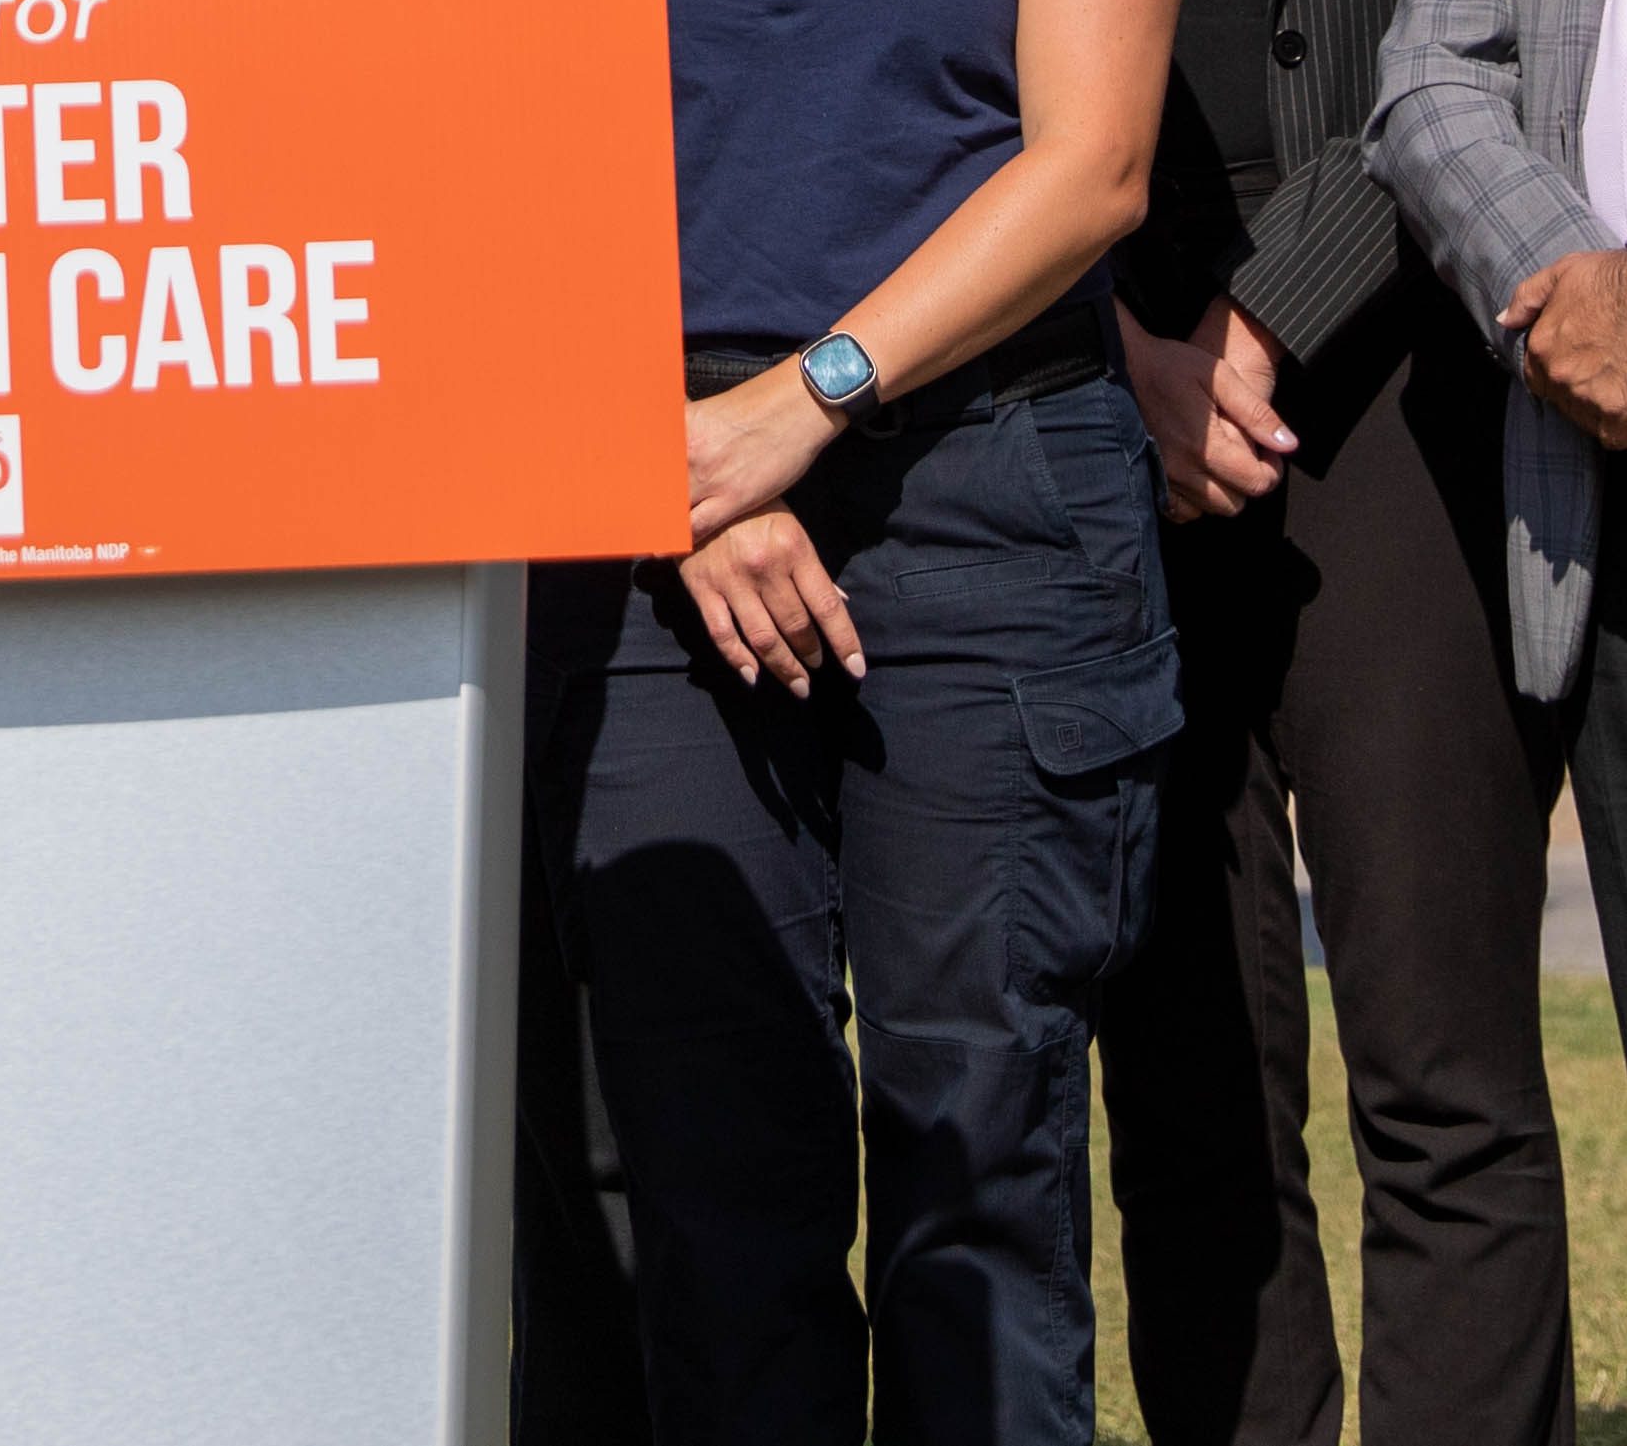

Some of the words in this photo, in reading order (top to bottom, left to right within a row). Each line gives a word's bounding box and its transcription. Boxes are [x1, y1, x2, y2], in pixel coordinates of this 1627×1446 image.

[48, 239, 382, 395] CARE
[20, 545, 93, 565] Manitoba
[95, 542, 130, 562] NDP
